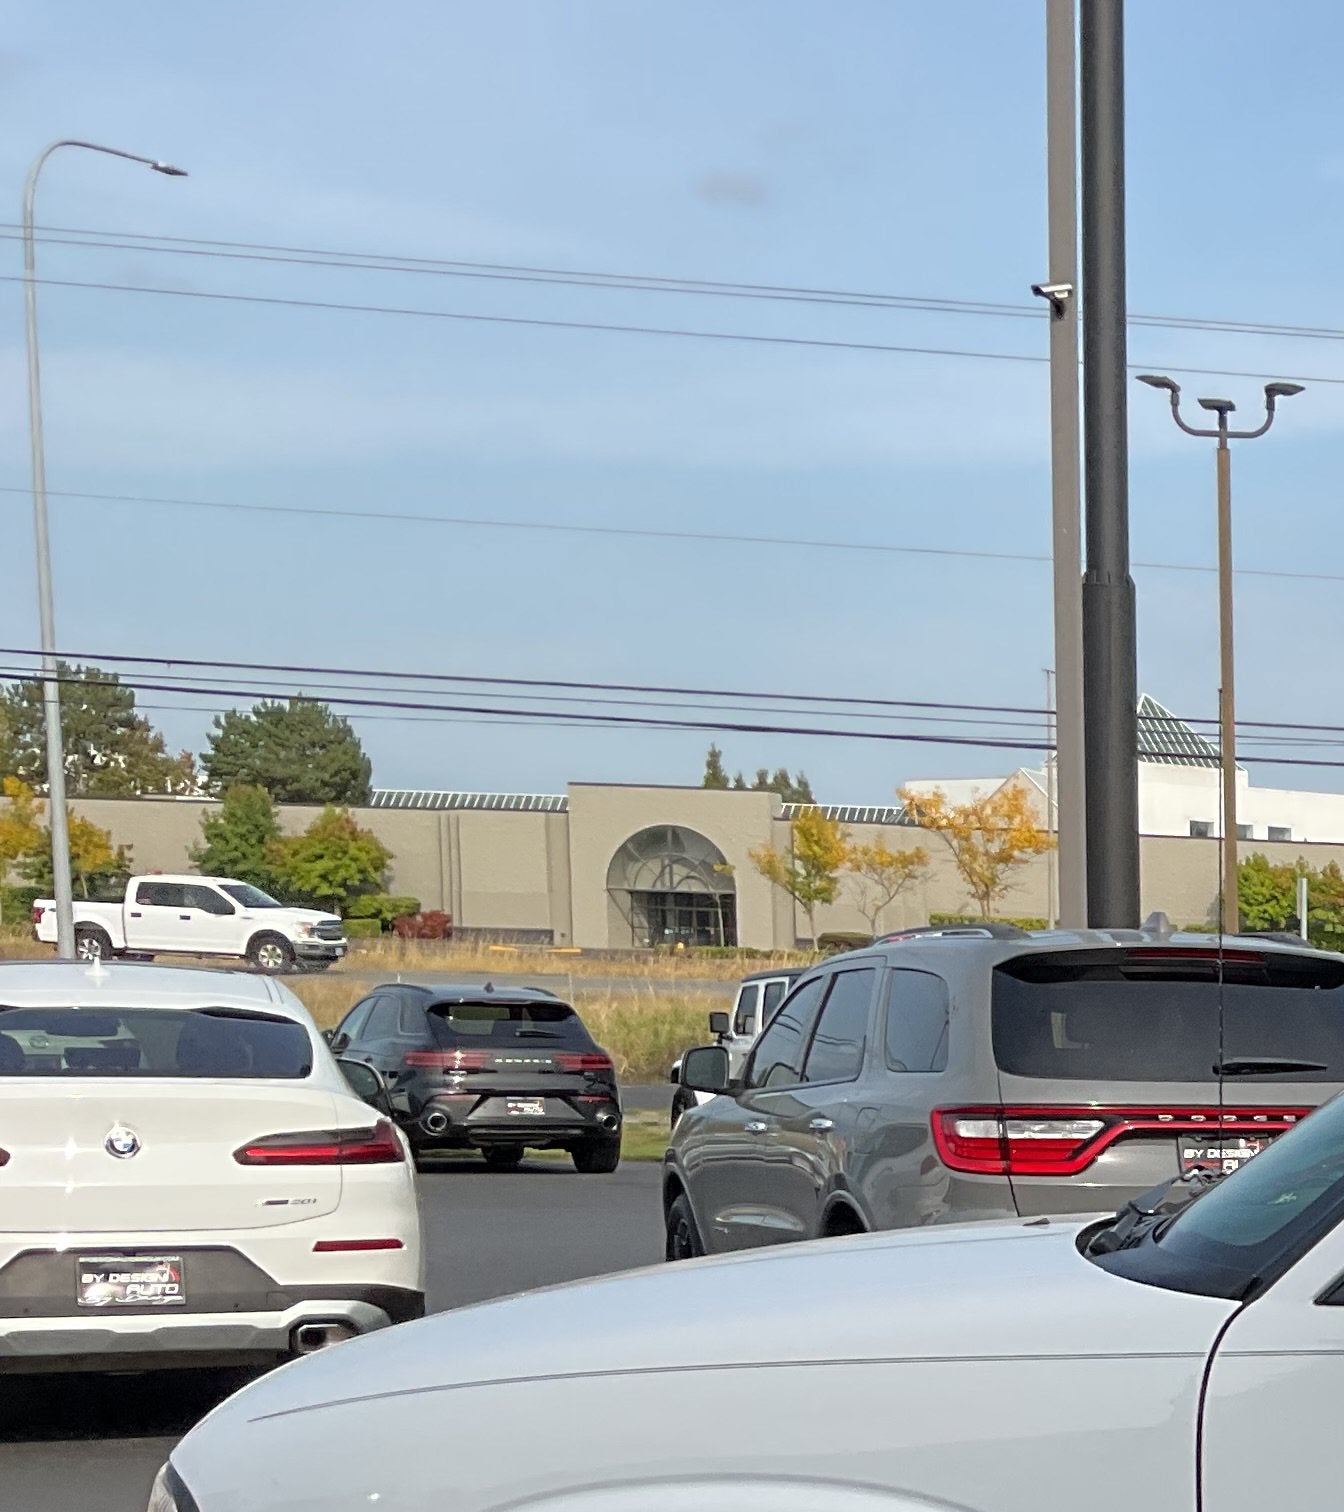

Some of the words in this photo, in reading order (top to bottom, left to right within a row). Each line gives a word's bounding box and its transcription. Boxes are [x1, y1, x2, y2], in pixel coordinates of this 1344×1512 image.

[1183, 1149, 1204, 1159] BY
[81, 1273, 105, 1284] BY
[108, 1273, 169, 1283] DESIGN
[125, 1283, 179, 1296] AUTO
